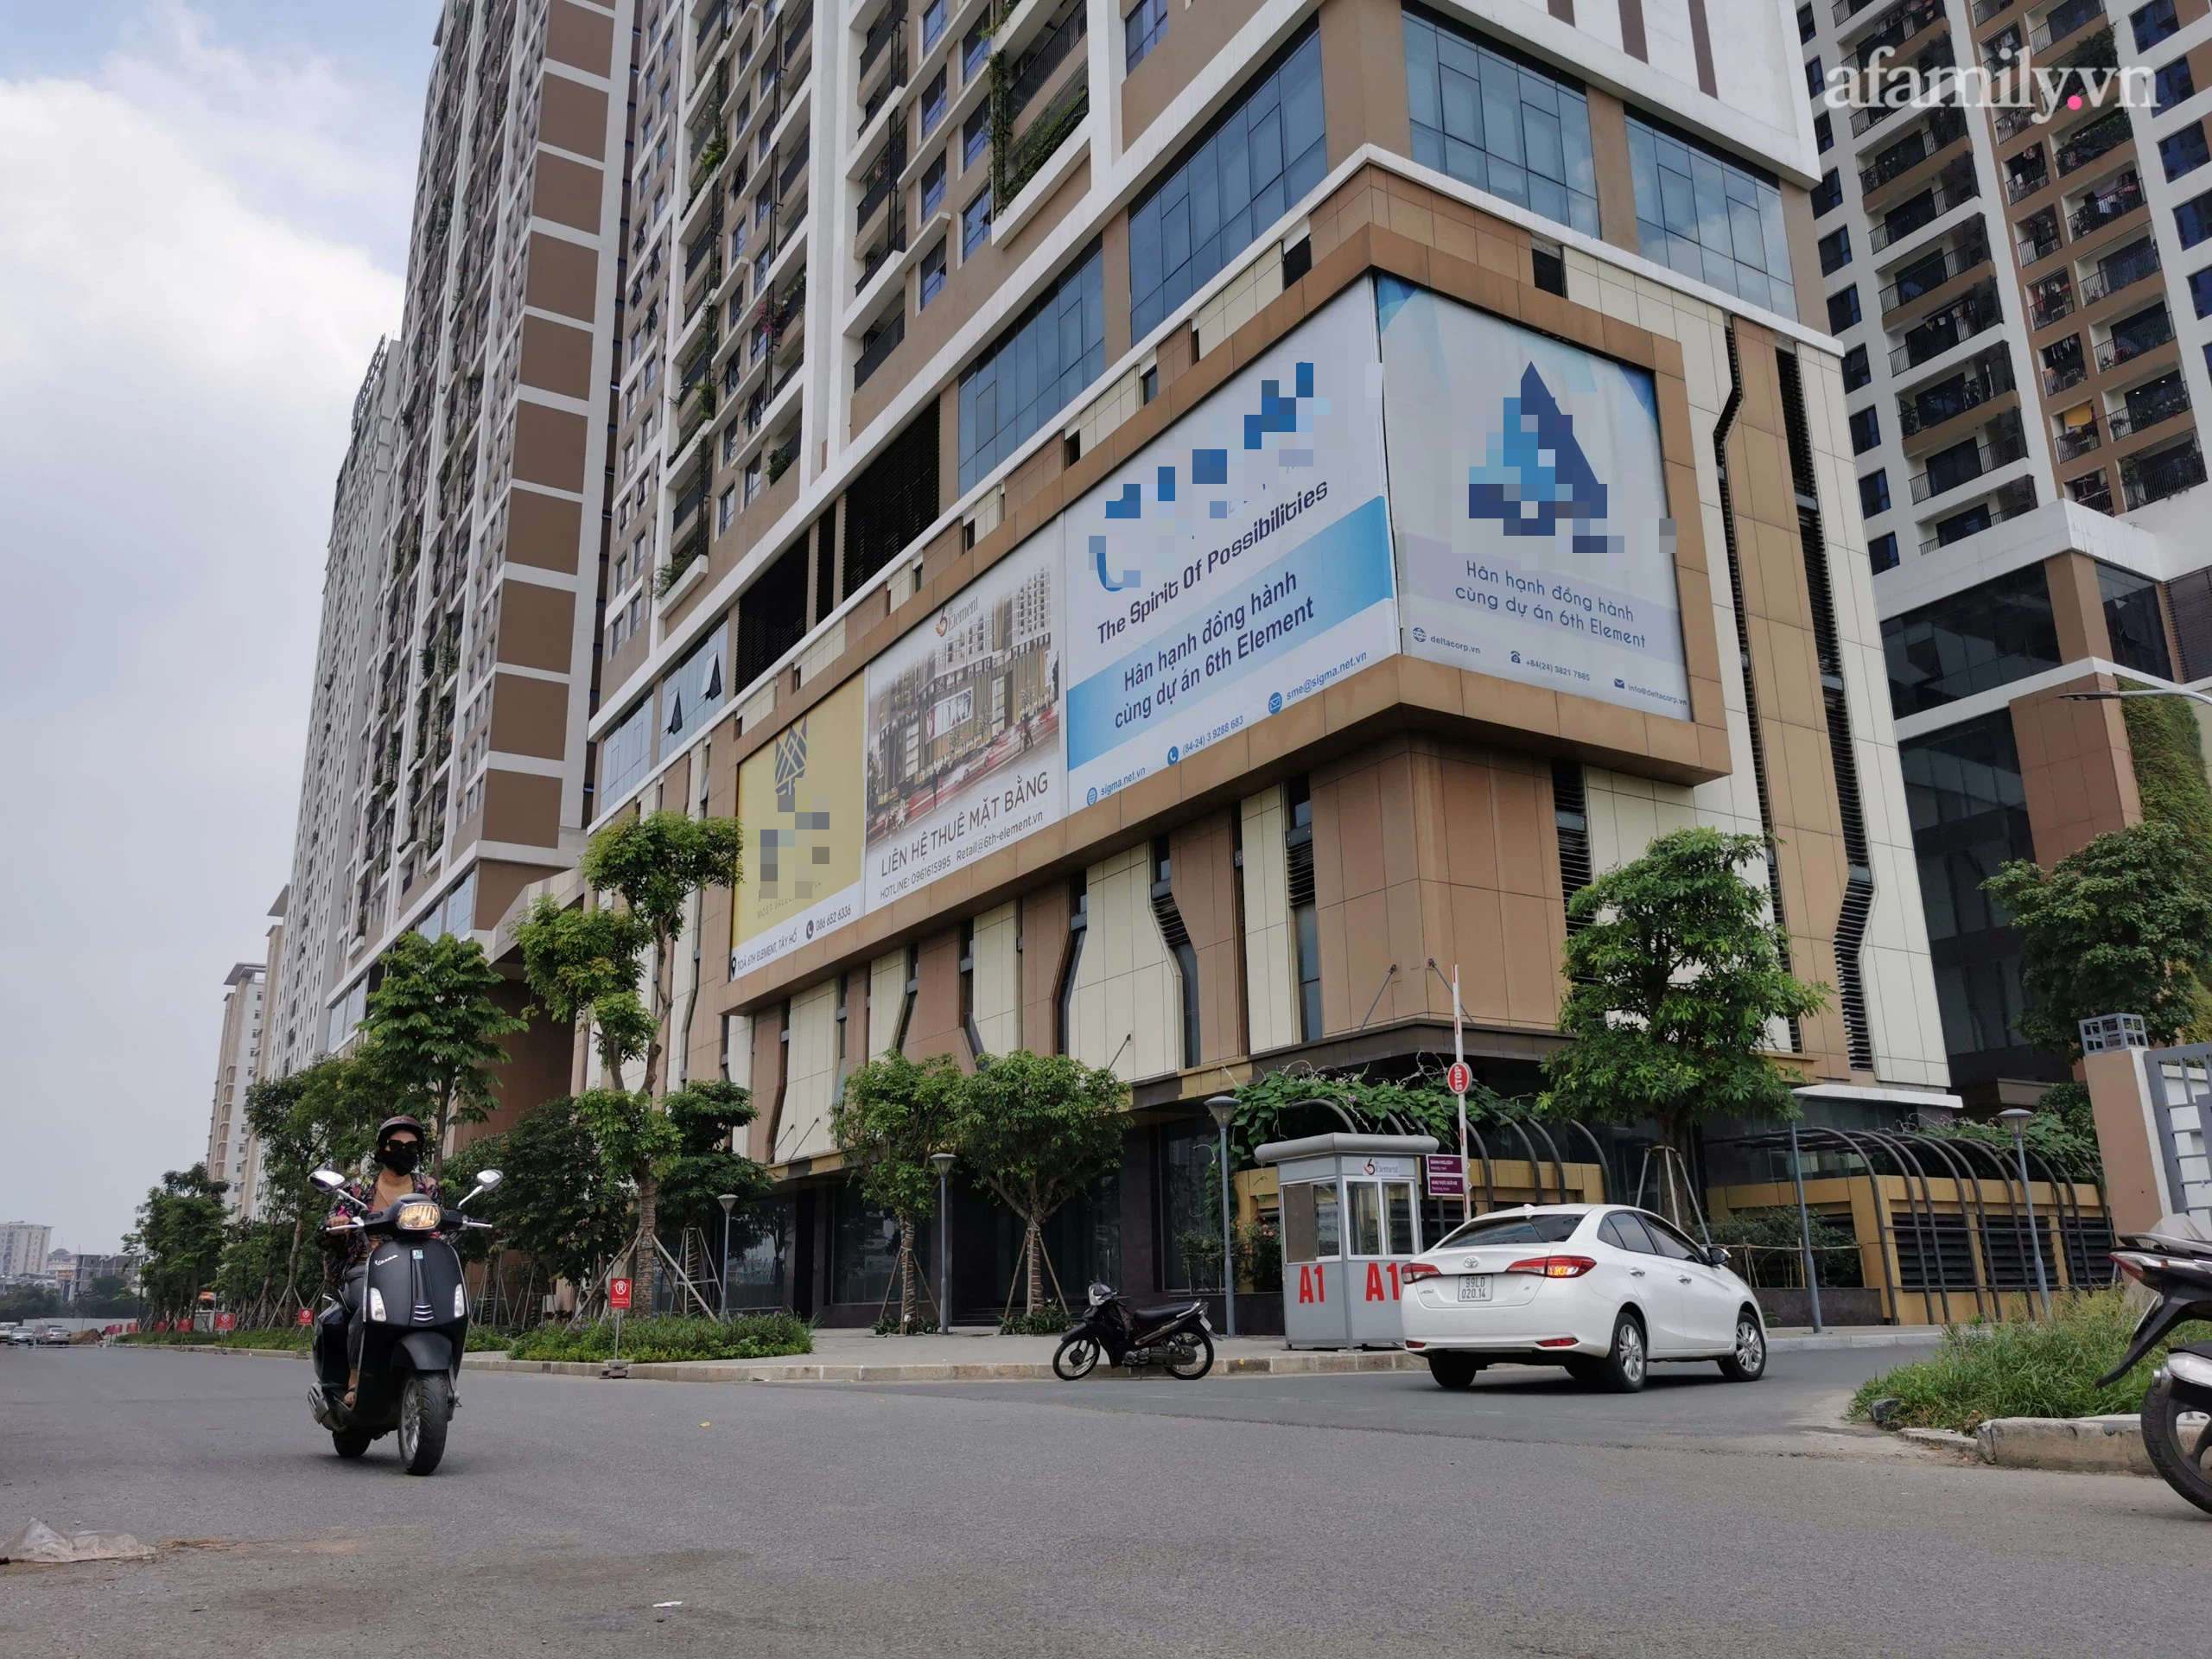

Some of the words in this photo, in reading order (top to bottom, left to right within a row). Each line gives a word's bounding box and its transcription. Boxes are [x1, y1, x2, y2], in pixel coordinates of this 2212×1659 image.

[1097, 617, 1126, 645] The
[1130, 580, 1179, 625] Spirit
[1183, 558, 1202, 588] Of
[1207, 481, 1328, 574] Possibilities
[1466, 560, 1498, 584] Hân
[1505, 570, 1545, 595] hạnh
[1598, 597, 1634, 622] hành
[948, 595, 978, 632] Element
[1124, 661, 1153, 692] Hân
[1158, 632, 1197, 671] hạnh
[1202, 605, 1245, 645] đồng
[1252, 571, 1297, 616] hành
[1455, 587, 1498, 610] cùng
[1505, 596, 1528, 617] dự
[1533, 604, 1554, 622] án
[1560, 610, 1584, 631] 6th
[1590, 618, 1645, 648] Element
[1115, 696, 1151, 728] cùng
[1156, 677, 1177, 705] dự
[1181, 667, 1200, 692] án
[1205, 646, 1231, 677] 6th
[1237, 596, 1314, 659] Element
[1430, 635, 1481, 654] deltacorp.vn
[1286, 652, 1367, 702] sme@sigma.net.vn
[1526, 659, 1553, 673] +84(24)
[1628, 683, 1688, 706] info@deltacorp.vn
[1183, 735, 1205, 756] (84-24)
[1207, 732, 1211, 741] 3
[1230, 715, 1244, 729] 683
[1101, 767, 1146, 796] sigma.net.vn
[881, 847, 907, 877] LIÊN
[911, 831, 928, 861] HỆ
[931, 811, 965, 851] THUÊ
[969, 797, 999, 830] MẶT
[1004, 772, 1048, 813] BẰNG
[957, 811, 1043, 861] Retail@6th-element.vn
[880, 877, 910, 900] HOTLINE:
[911, 855, 951, 884] 0961615995
[826, 913, 837, 926] 652
[1454, 1065, 1463, 1090] STOP
[1299, 1264, 1325, 1304] A1
[1365, 1262, 1400, 1301] A1
[1461, 1288, 1486, 1299] 020.14
[1465, 1277, 1485, 1287] 99LD
